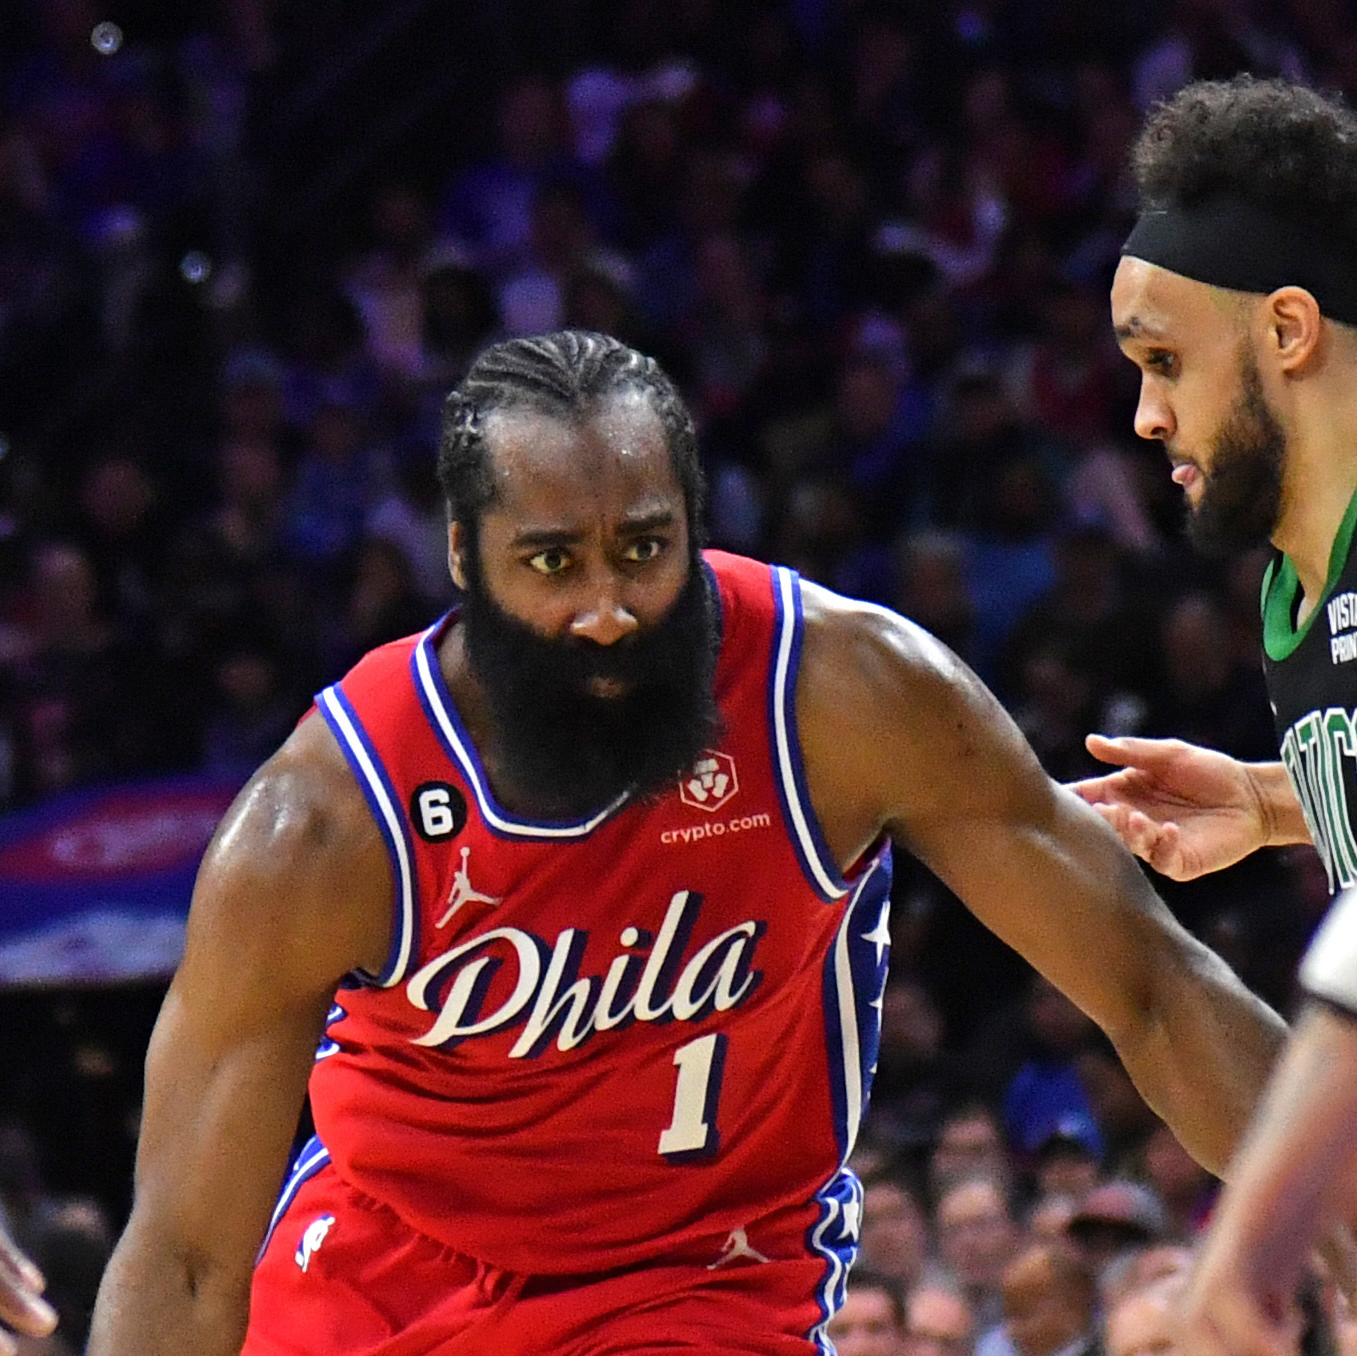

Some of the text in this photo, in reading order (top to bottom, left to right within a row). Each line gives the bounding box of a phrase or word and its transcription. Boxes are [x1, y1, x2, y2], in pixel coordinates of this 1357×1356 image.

[418, 788, 454, 837] 6
[660, 812, 771, 845] crypto.com
[406, 889, 762, 1059] Phila
[657, 1032, 727, 1161] 1
